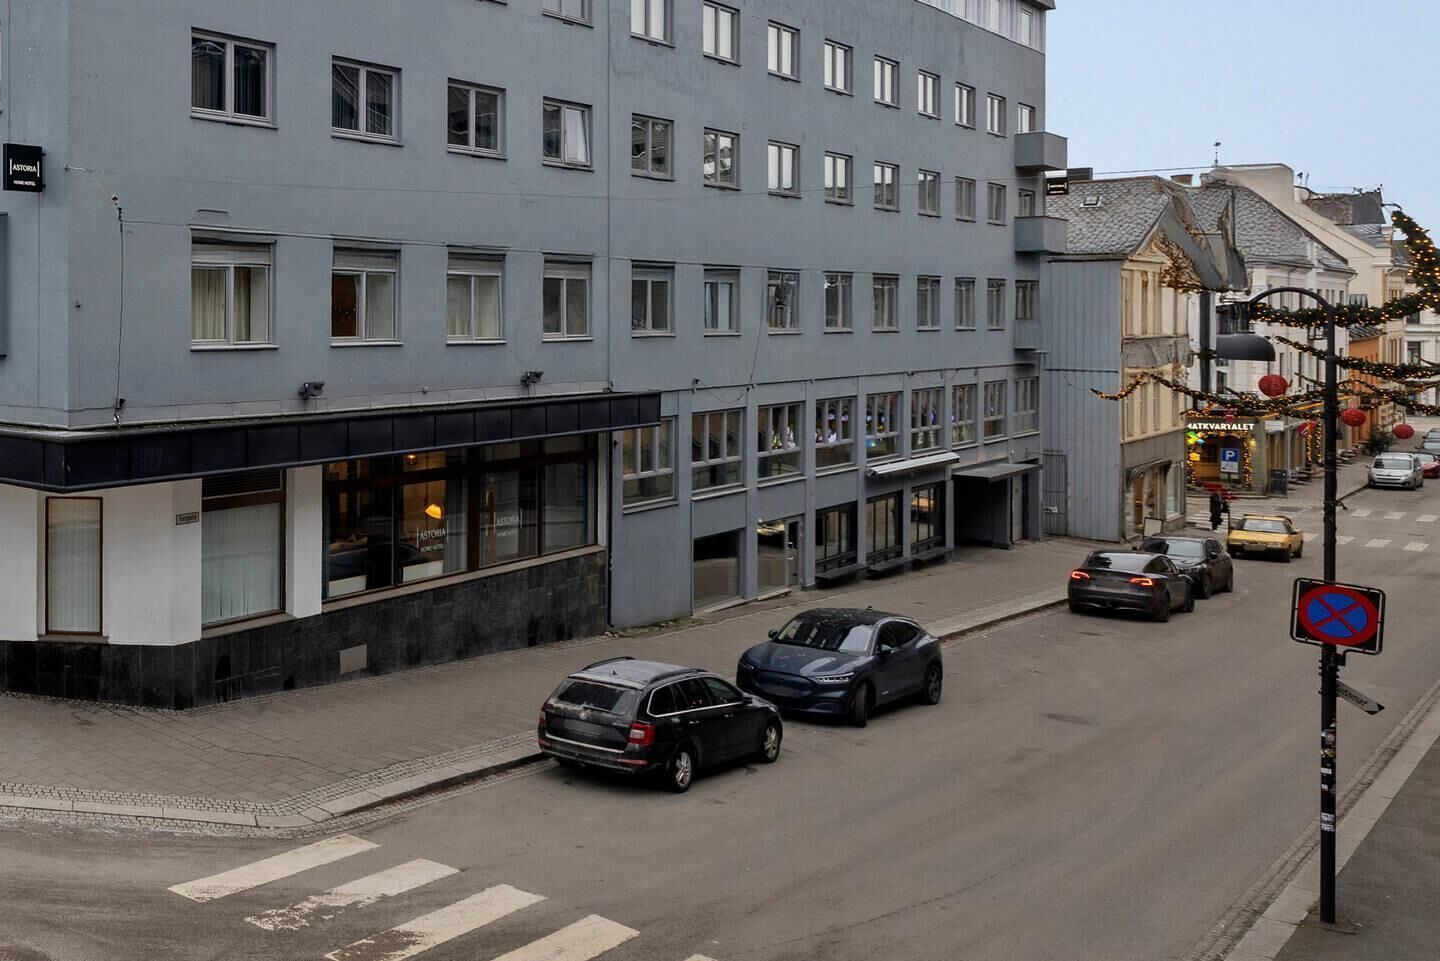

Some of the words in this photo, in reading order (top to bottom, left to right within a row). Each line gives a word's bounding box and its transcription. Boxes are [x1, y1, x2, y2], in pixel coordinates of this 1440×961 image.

[12, 163, 37, 173] ASTORIA
[1225, 450, 1236, 460] P
[419, 528, 446, 541] ASTORIA
